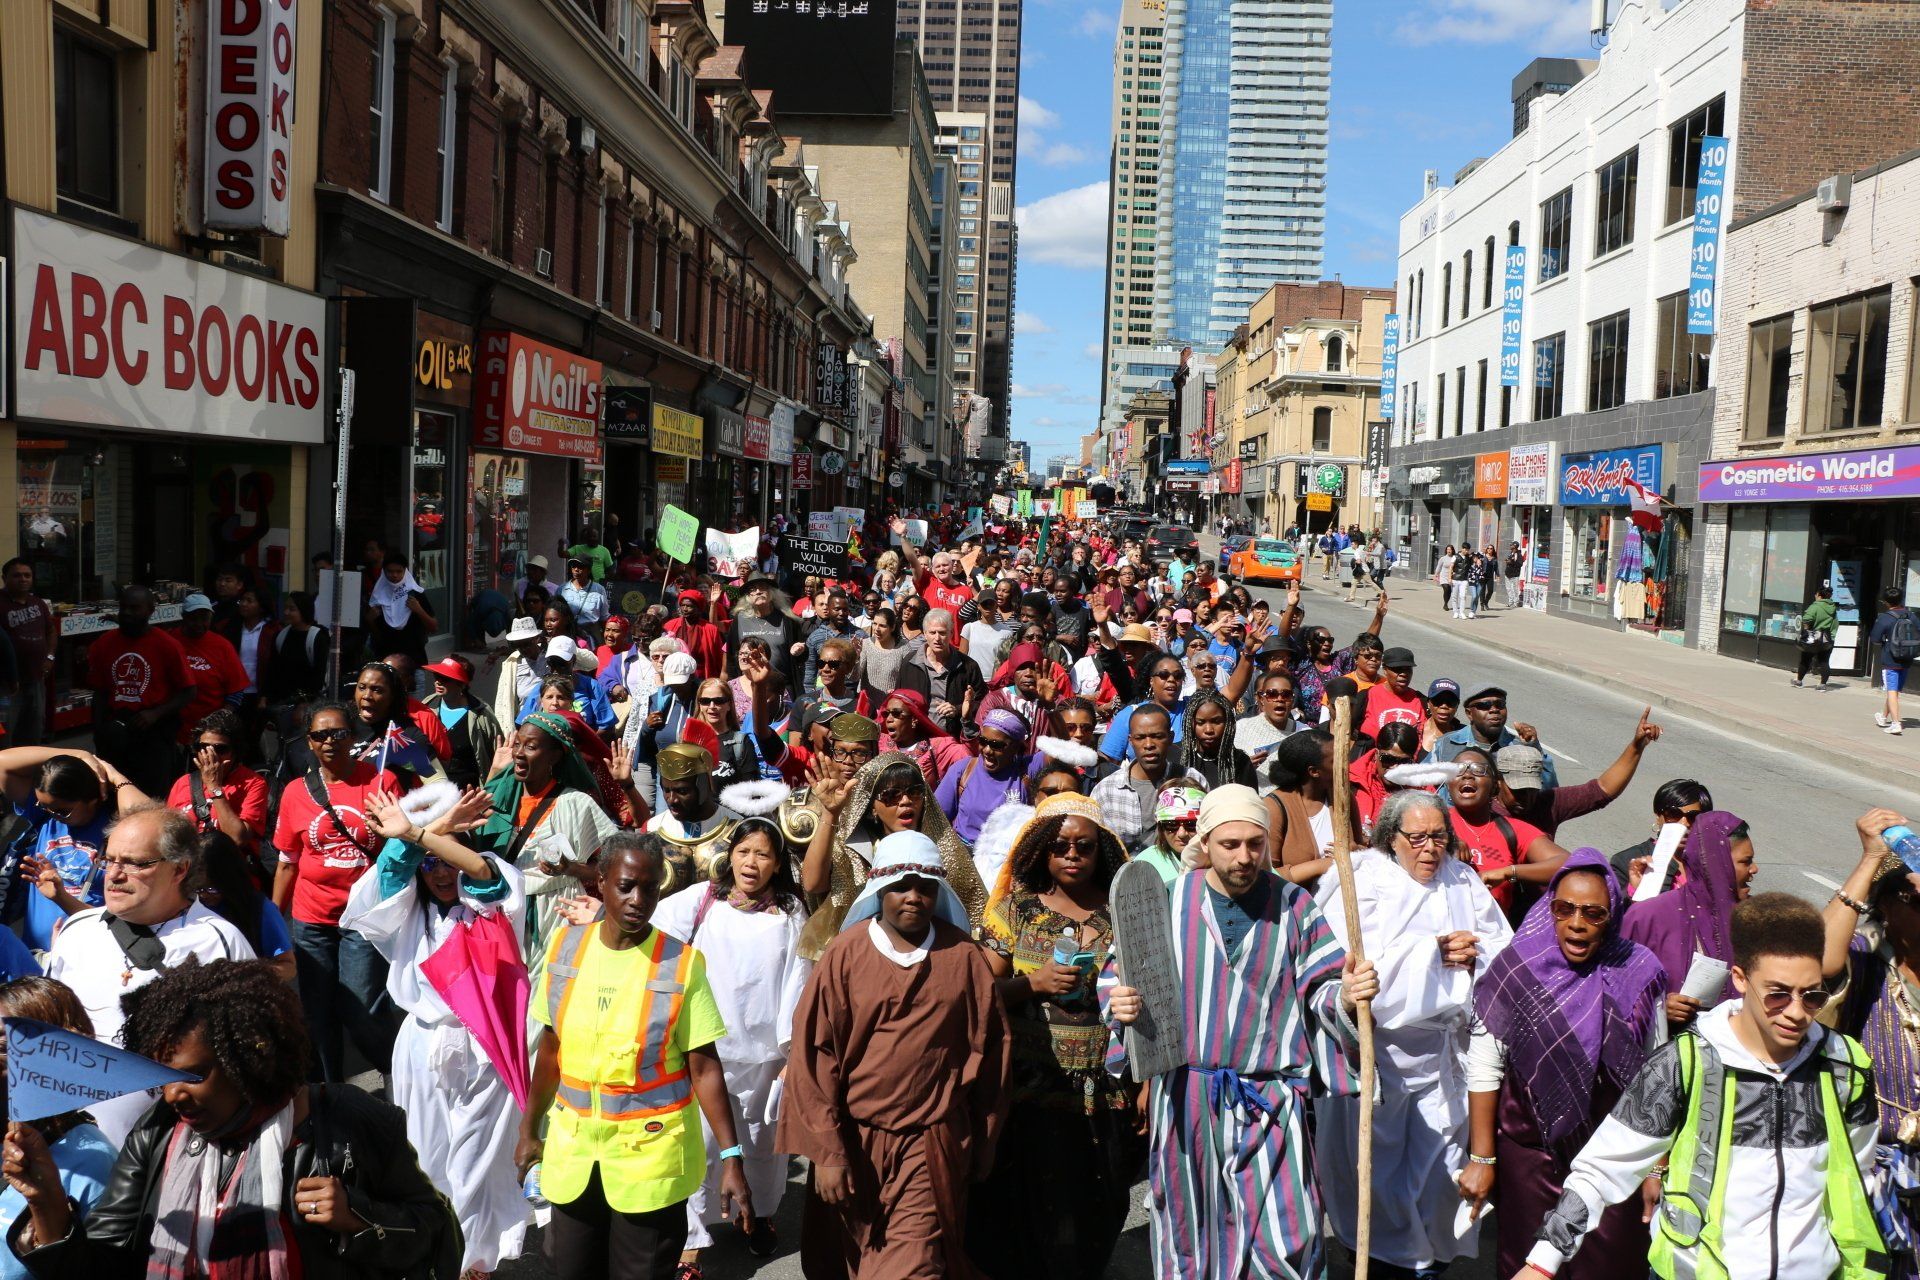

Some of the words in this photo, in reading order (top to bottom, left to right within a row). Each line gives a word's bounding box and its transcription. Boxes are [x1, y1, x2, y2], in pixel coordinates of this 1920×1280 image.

[270, 0, 292, 202] OKS
[1701, 146, 1725, 168] $10
[1703, 169, 1717, 177] Per
[1698, 177, 1722, 186] Month
[1696, 194, 1720, 216] $10
[1694, 225, 1717, 234] Month
[1699, 218, 1712, 226] Per
[1506, 252, 1524, 268] $10
[1692, 242, 1715, 263] $10
[1695, 264, 1708, 272] Per
[1690, 272, 1713, 281] Month
[1504, 285, 1522, 300] $10
[1689, 288, 1712, 309] $10
[1688, 318, 1712, 327] Month
[1693, 311, 1706, 319] Per
[1385, 319, 1398, 330] $10
[1503, 319, 1520, 334] $10
[24, 263, 149, 387] ABC
[163, 294, 320, 411] BOOKS
[1383, 343, 1396, 354] $10
[448, 344, 472, 374] BAR
[1502, 352, 1519, 368] $10
[816, 345, 825, 402] HOT
[824, 345, 835, 402] YOGA
[1382, 368, 1395, 379] $10
[482, 336, 508, 443] NAILS
[529, 351, 597, 415] Nail's
[833, 383, 842, 408] YOGA
[1381, 392, 1394, 404] $10
[533, 412, 593, 435] ATTRACTION
[607, 423, 646, 432] M'ZAAR
[1510, 454, 1546, 467] CELLPHONE
[796, 460, 807, 480] SPA
[1324, 471, 1335, 482] P
[1510, 467, 1528, 478] REPAIR
[1528, 465, 1547, 478] CENTER
[1720, 461, 1816, 486] Cosmetic
[1822, 453, 1895, 481] World
[467, 456, 475, 514] HAIR
[1744, 489, 1759, 497] YONGE
[809, 513, 834, 521] JESUS
[808, 523, 831, 531] NEVER
[672, 542, 685, 554] LIFE
[788, 538, 808, 550] THE
[814, 542, 844, 554] LORD
[801, 552, 826, 564] WILL
[792, 562, 837, 577] PROVIDE
[7, 604, 42, 629] GUESS
[150, 605, 176, 622] EDUCED
[119, 662, 140, 680] Joy
[9, 1021, 118, 1074] CHRIST
[1695, 1046, 1722, 1179] JESUS
